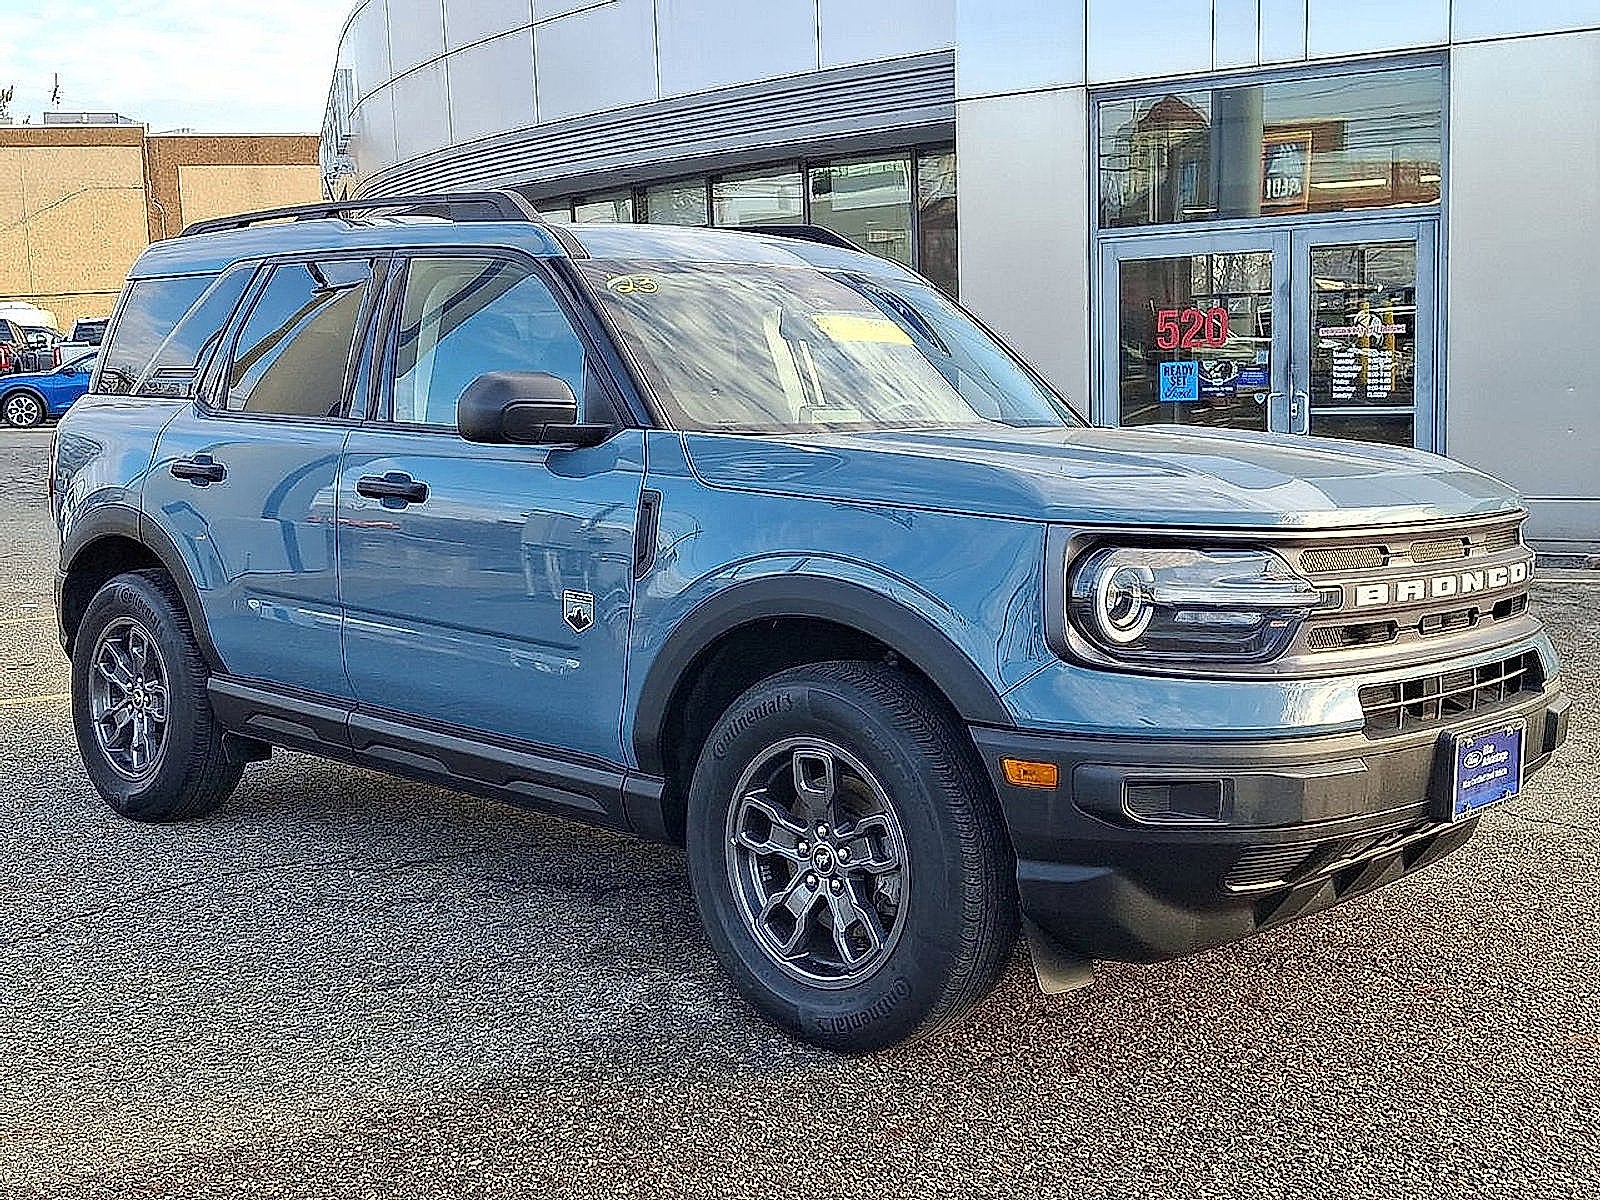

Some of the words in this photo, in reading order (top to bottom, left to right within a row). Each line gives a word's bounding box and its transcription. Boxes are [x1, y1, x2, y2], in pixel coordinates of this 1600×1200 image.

[1157, 307, 1229, 349] 520
[1163, 365, 1195, 377] READY
[1168, 377, 1187, 386] SET
[1355, 562, 1526, 607] BRONCO
[713, 695, 782, 760] Continental
